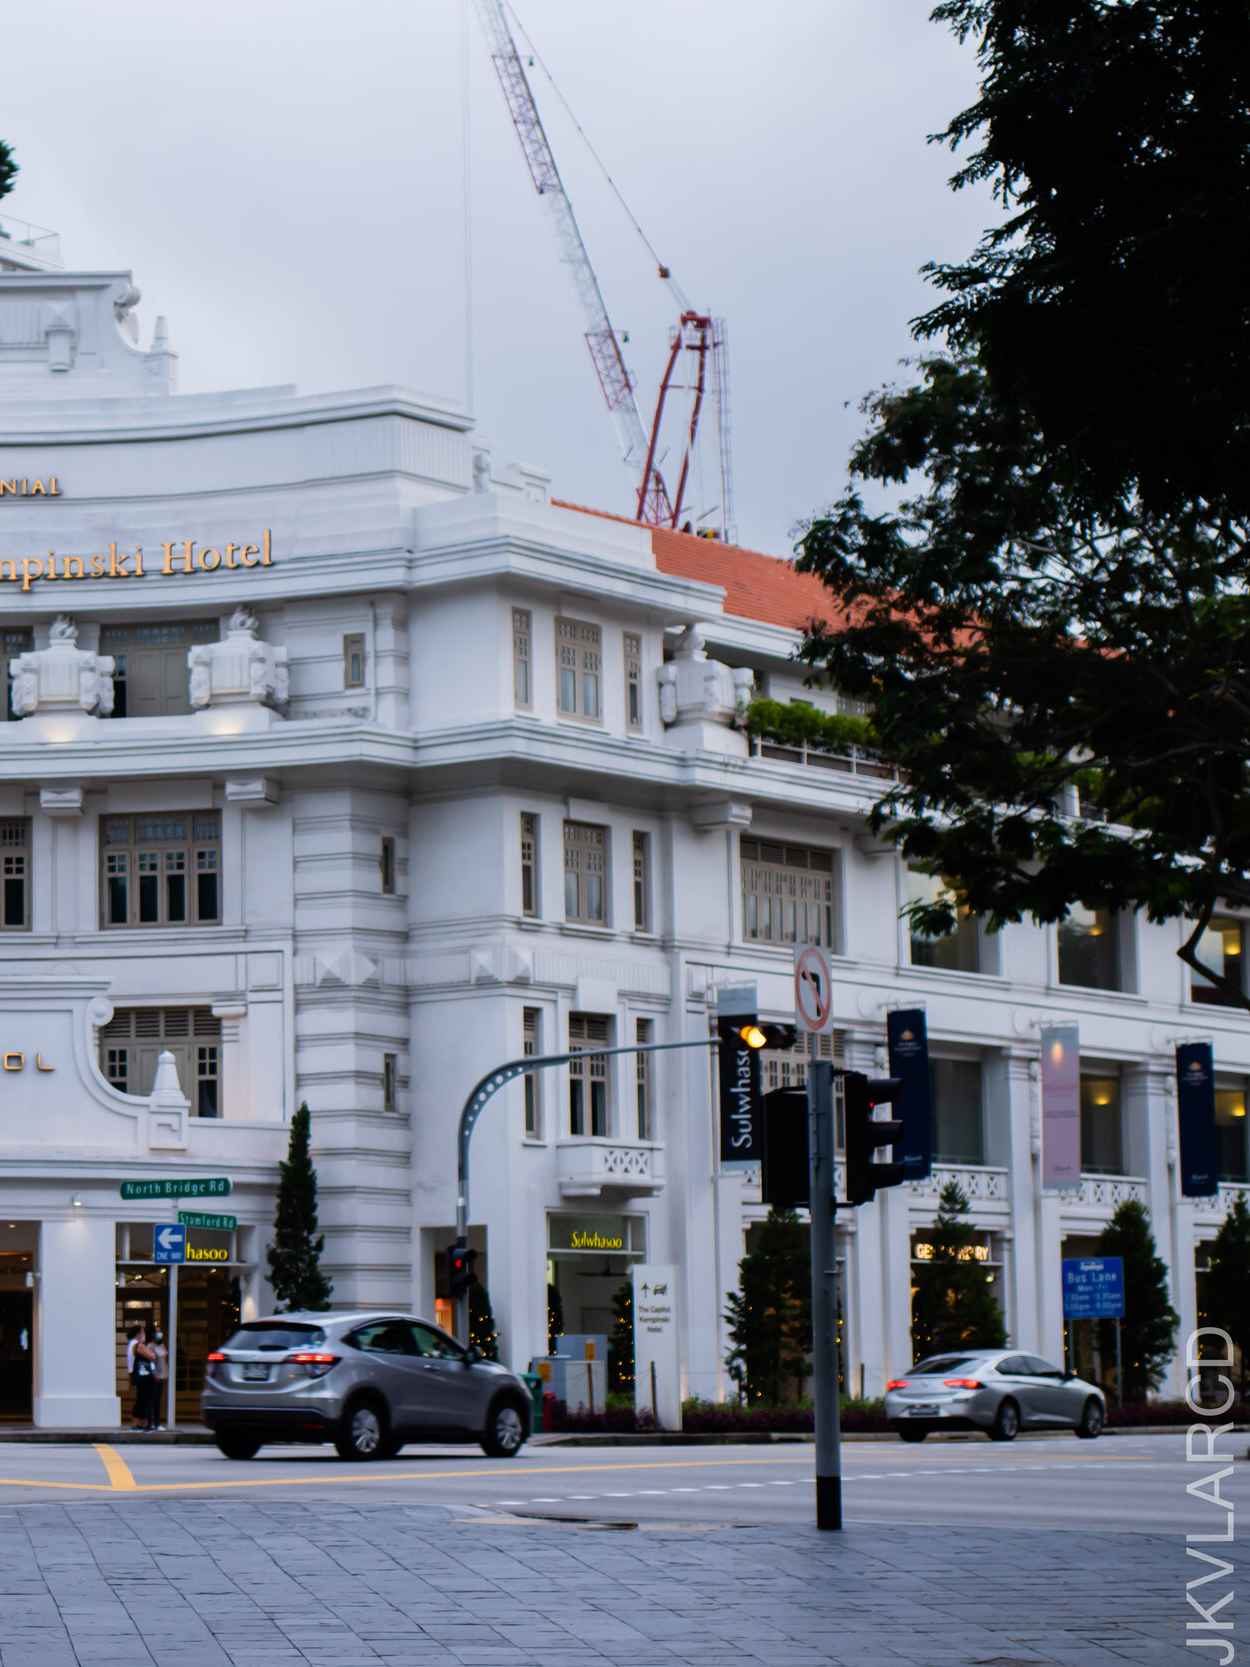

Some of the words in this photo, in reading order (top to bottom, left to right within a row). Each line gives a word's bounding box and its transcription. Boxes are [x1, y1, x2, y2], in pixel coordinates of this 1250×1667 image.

[160, 529, 274, 576] Hotel
[126, 1183, 161, 1194] North
[165, 1182, 205, 1195] Bridge
[210, 1180, 225, 1191] Rd
[180, 1213, 221, 1227] Stamford
[223, 1219, 234, 1229] Rd
[571, 1231, 623, 1249] Sulwhasoo
[156, 1252, 169, 1260] ONE
[186, 1242, 228, 1260] hasoo
[1067, 1271, 1087, 1284] Bus
[1092, 1271, 1117, 1283] Lane
